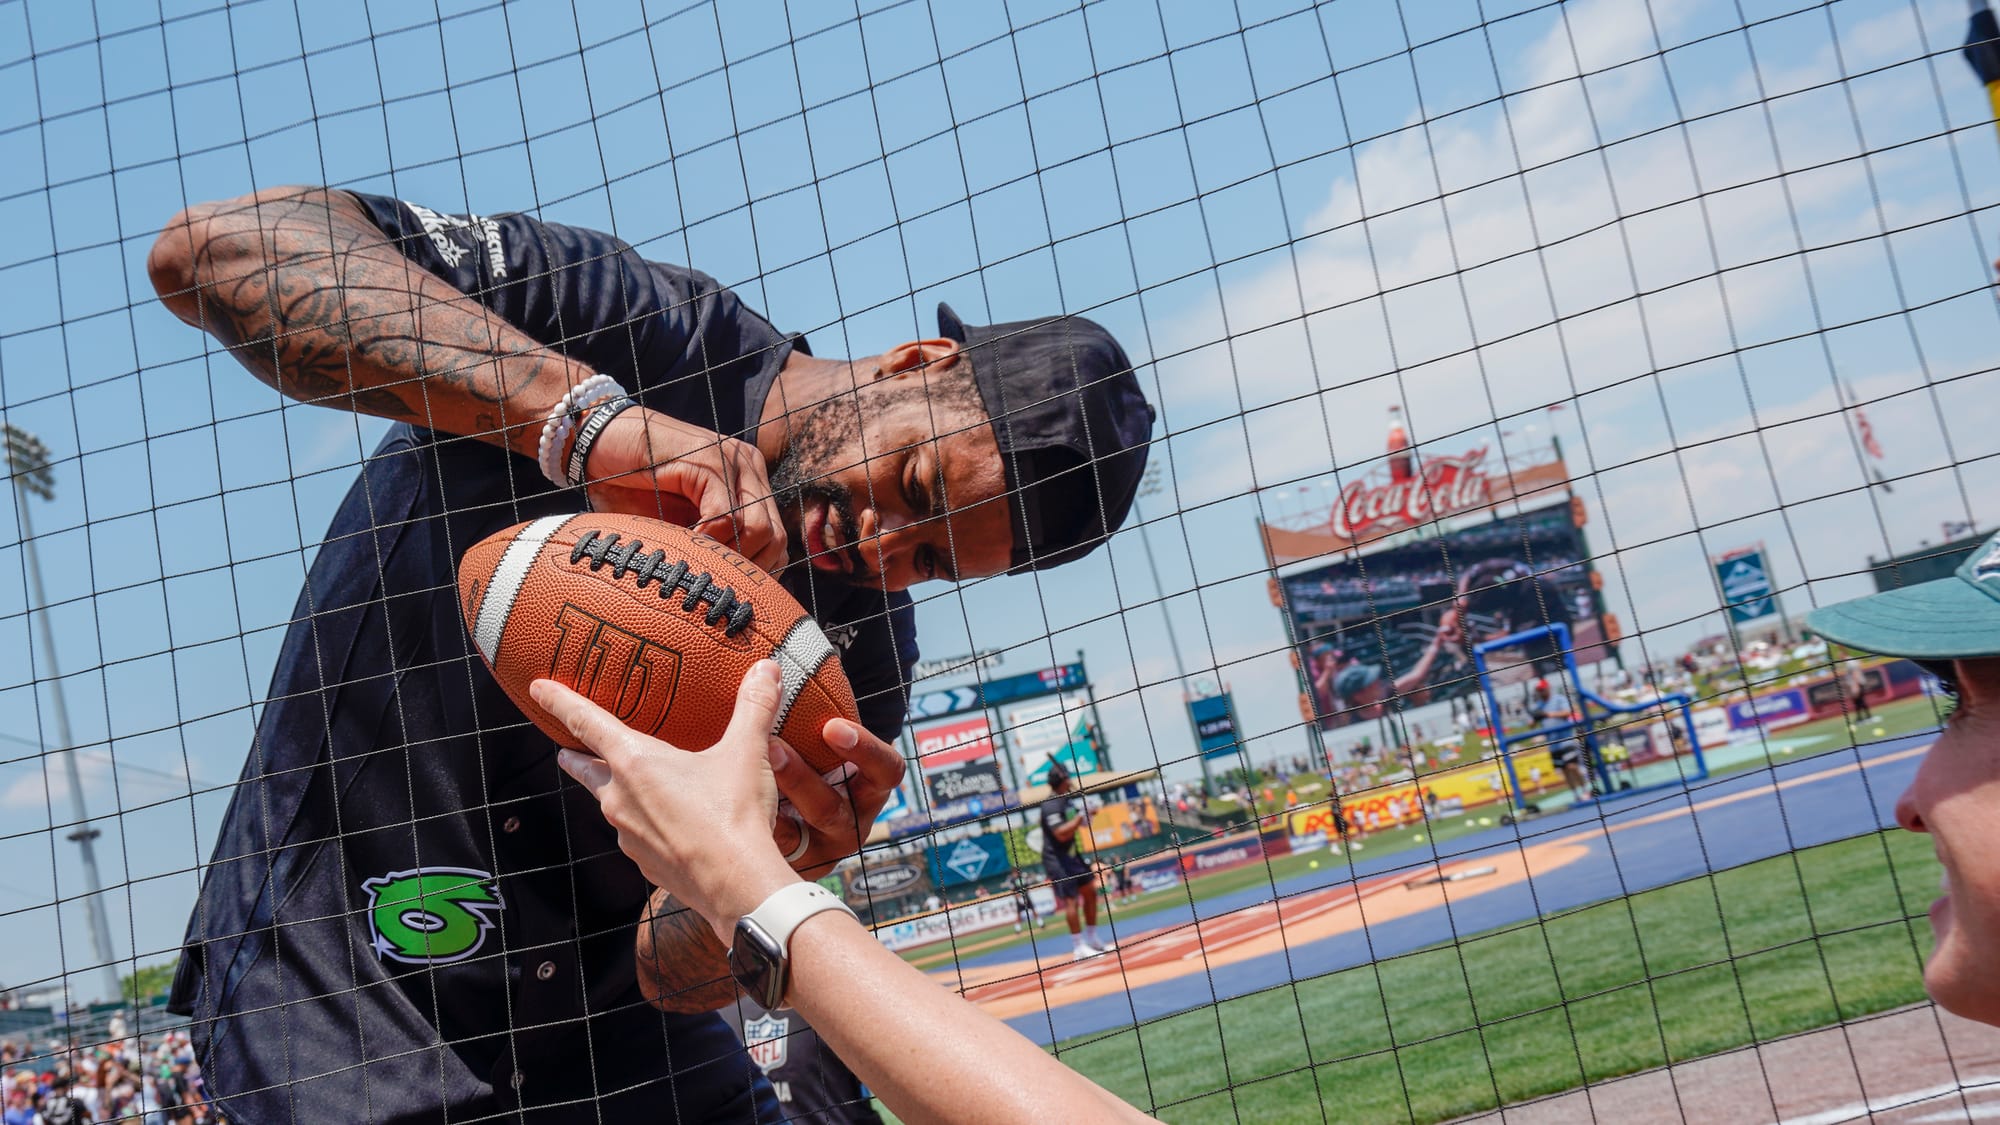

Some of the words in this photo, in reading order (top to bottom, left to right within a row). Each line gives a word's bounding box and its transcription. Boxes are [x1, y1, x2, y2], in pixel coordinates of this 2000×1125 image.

[577, 404, 613, 455] CULTURE
[919, 727, 990, 755] GIANT
[1196, 848, 1248, 868] Fanatics
[914, 911, 973, 938] People
[750, 1040, 780, 1065] NFL
